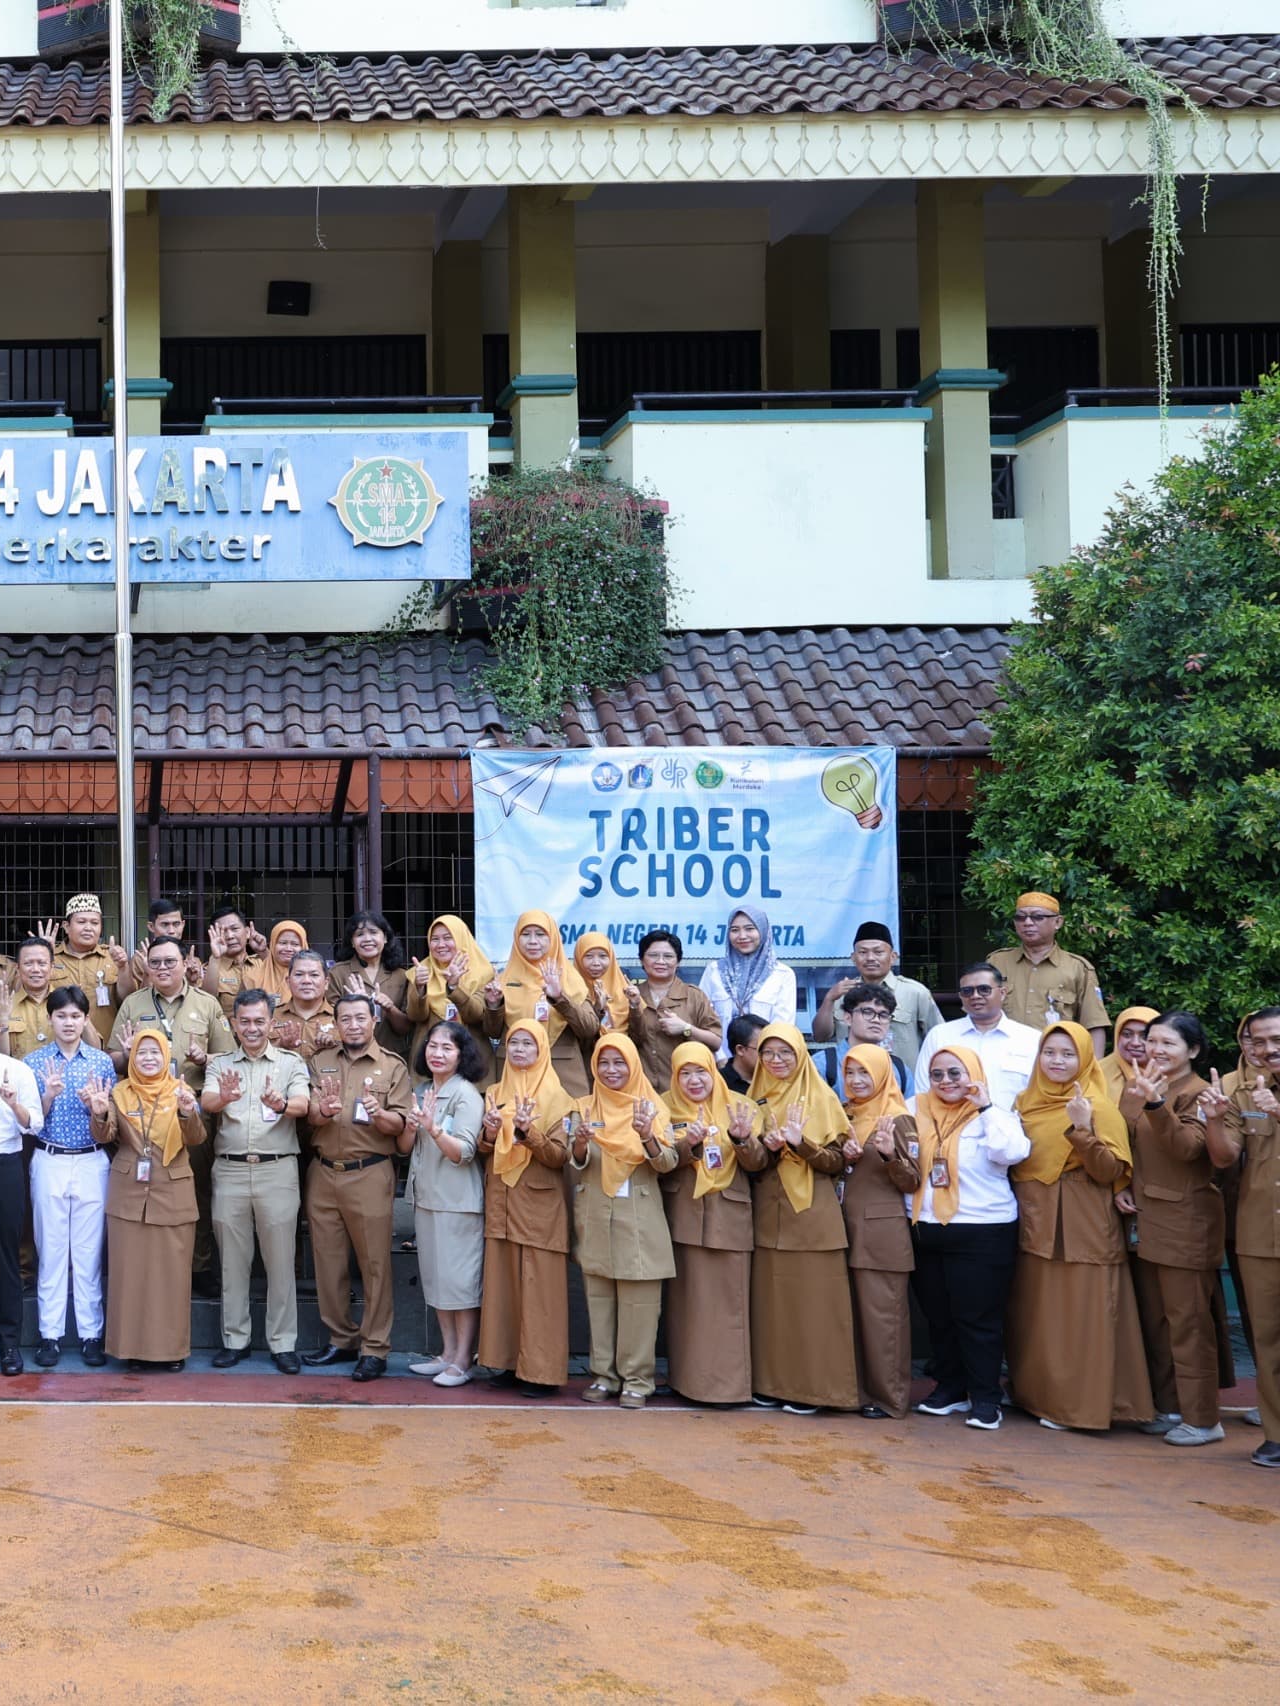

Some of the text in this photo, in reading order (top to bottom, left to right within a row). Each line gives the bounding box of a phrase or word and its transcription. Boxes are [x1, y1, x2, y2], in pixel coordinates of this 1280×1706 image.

[36, 446, 302, 516] JAKARTA
[367, 481, 407, 508] SMA
[377, 507, 397, 525] 14
[367, 525, 407, 538] JAKARTA
[588, 806, 772, 852] TRIBER
[577, 853, 783, 899] SCHOOL
[686, 924, 708, 945] 14
[714, 924, 805, 947] JRTA
